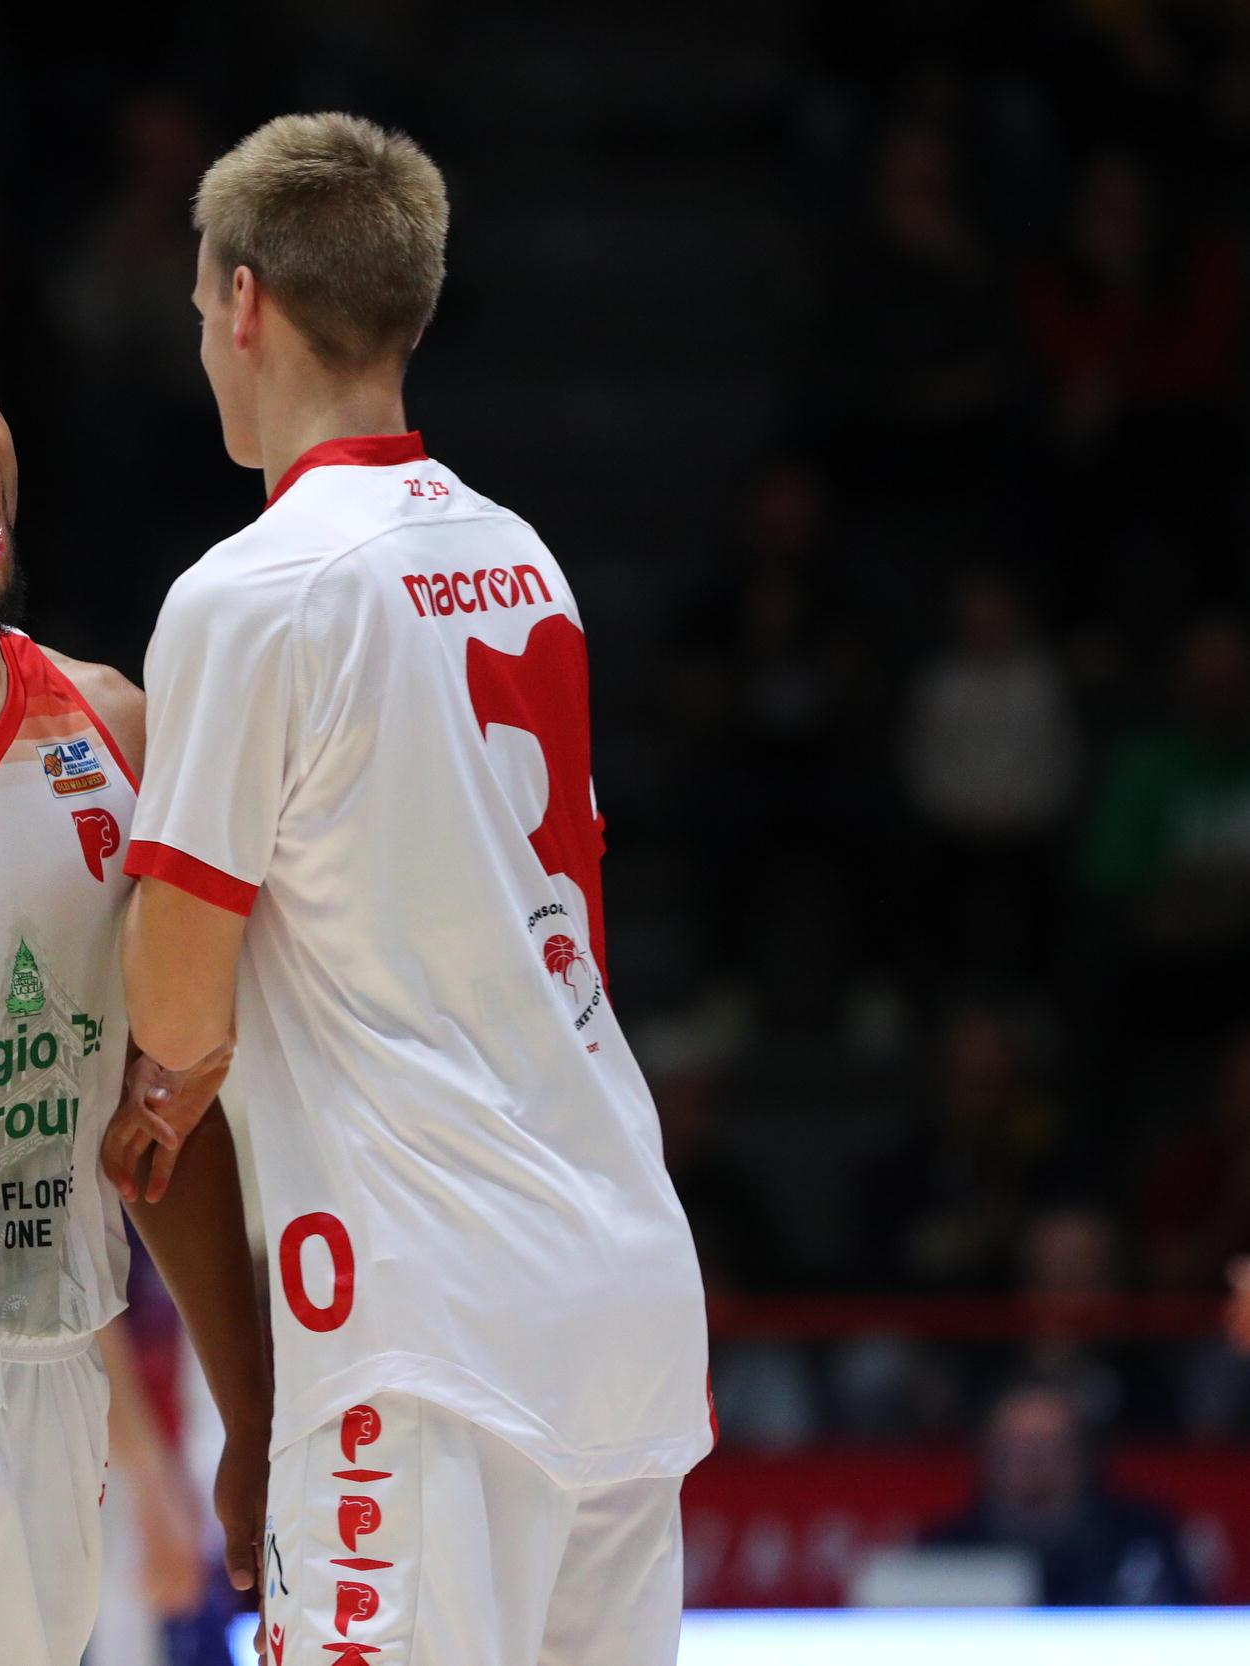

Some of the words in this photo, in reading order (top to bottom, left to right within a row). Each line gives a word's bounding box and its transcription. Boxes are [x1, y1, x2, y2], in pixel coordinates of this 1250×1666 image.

[402, 564, 553, 617] macron
[4, 1219, 52, 1249] ONE
[280, 1212, 355, 1333] 0
